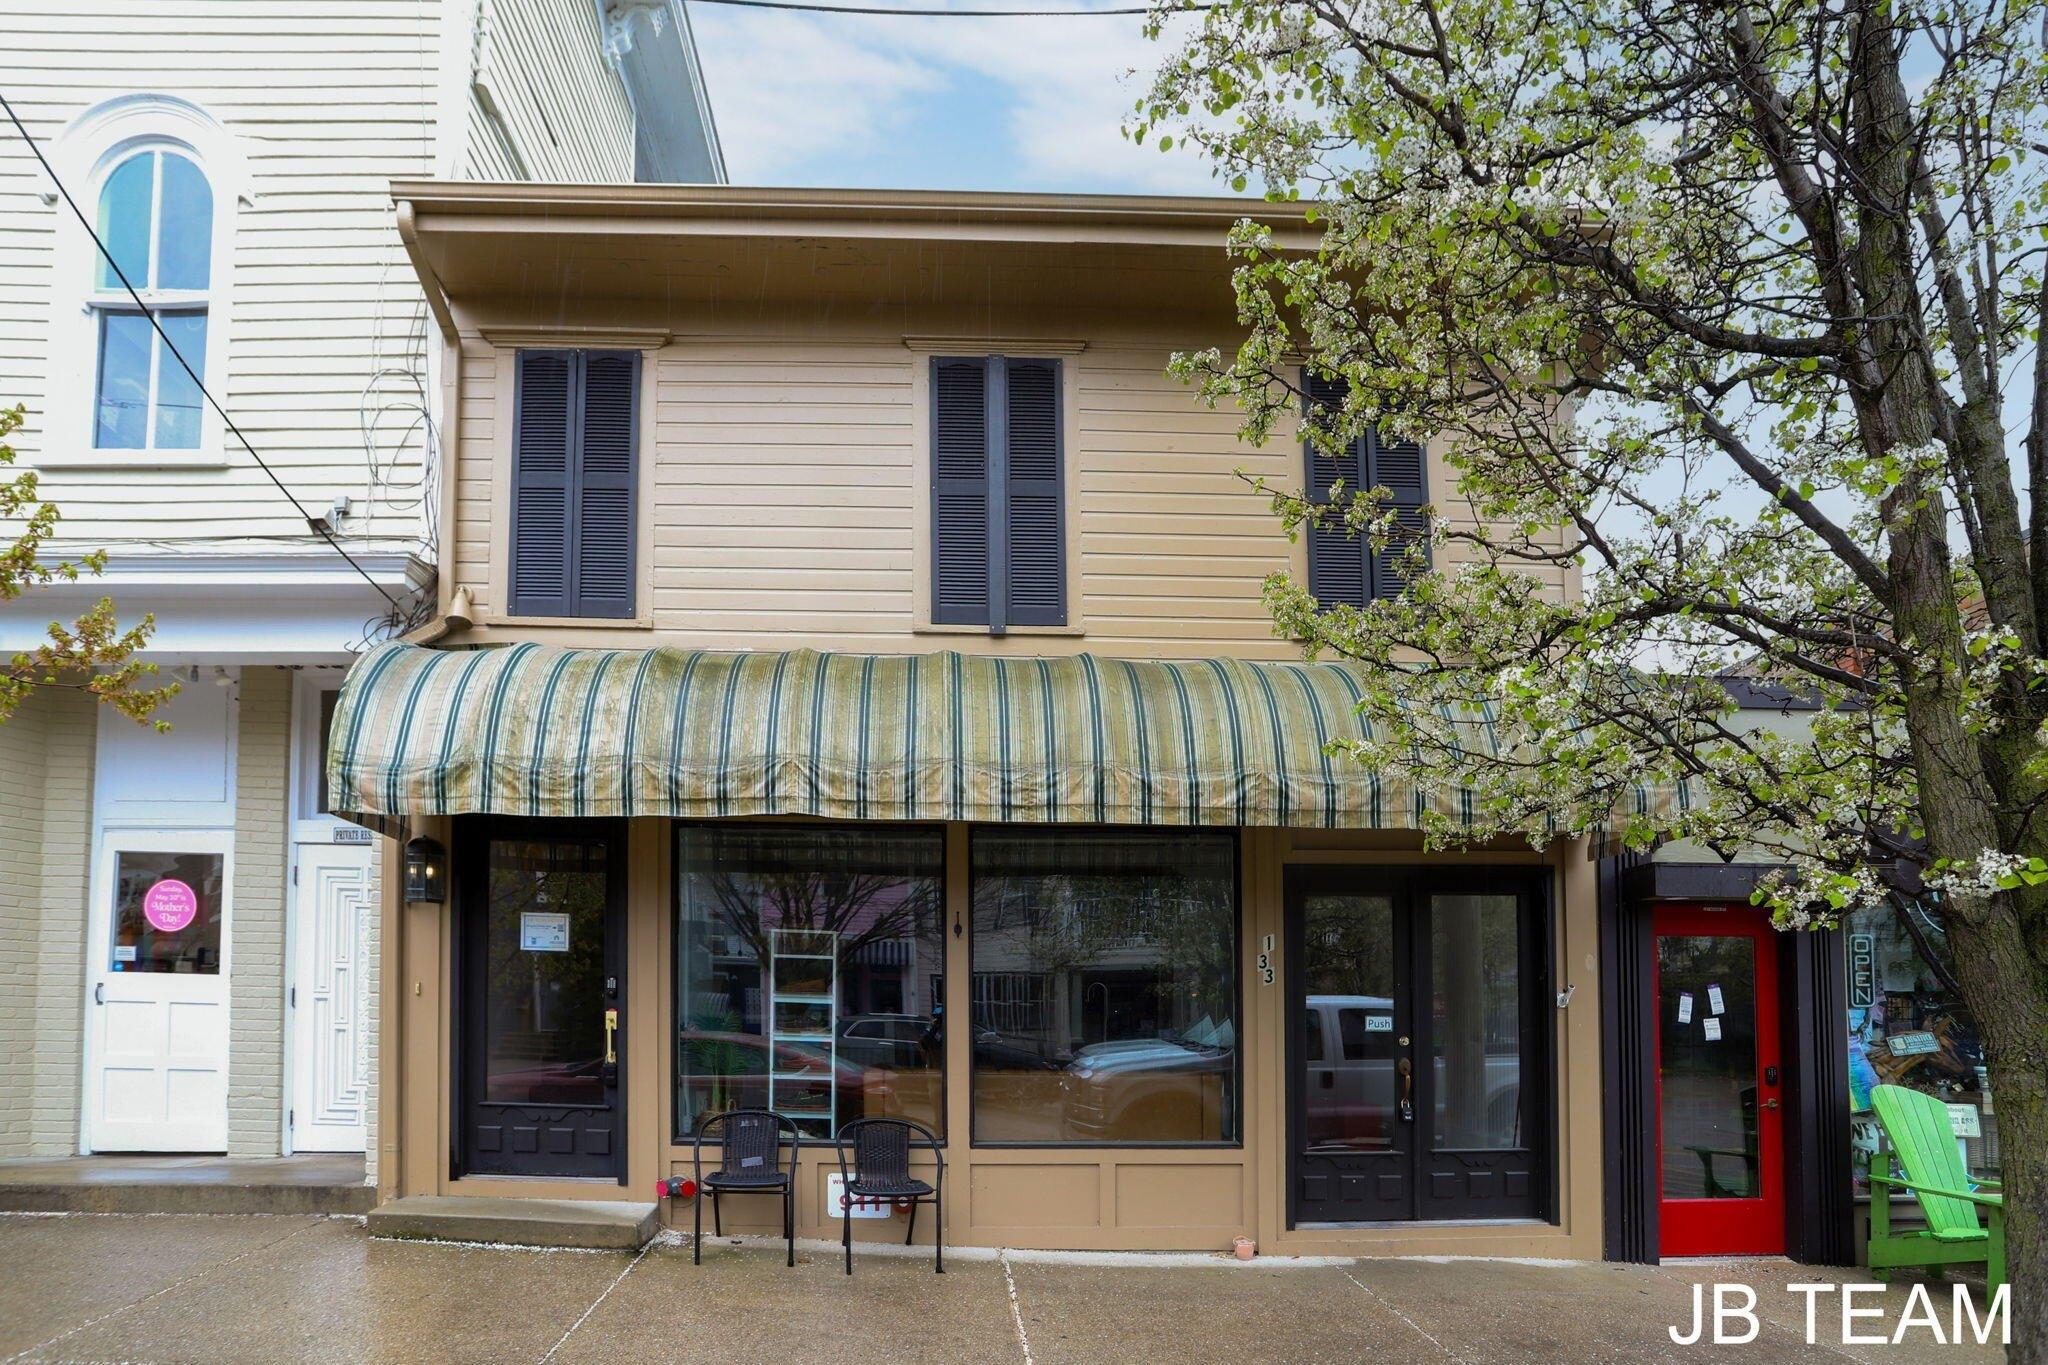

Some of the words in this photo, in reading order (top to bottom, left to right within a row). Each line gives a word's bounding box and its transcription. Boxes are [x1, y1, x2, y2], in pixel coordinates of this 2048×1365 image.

[335, 830, 359, 840] PRIVATE
[152, 902, 190, 911] Mother's
[160, 913, 181, 925] Day!
[1854, 939, 1872, 1004] OPEN
[1368, 1019, 1391, 1028] Push
